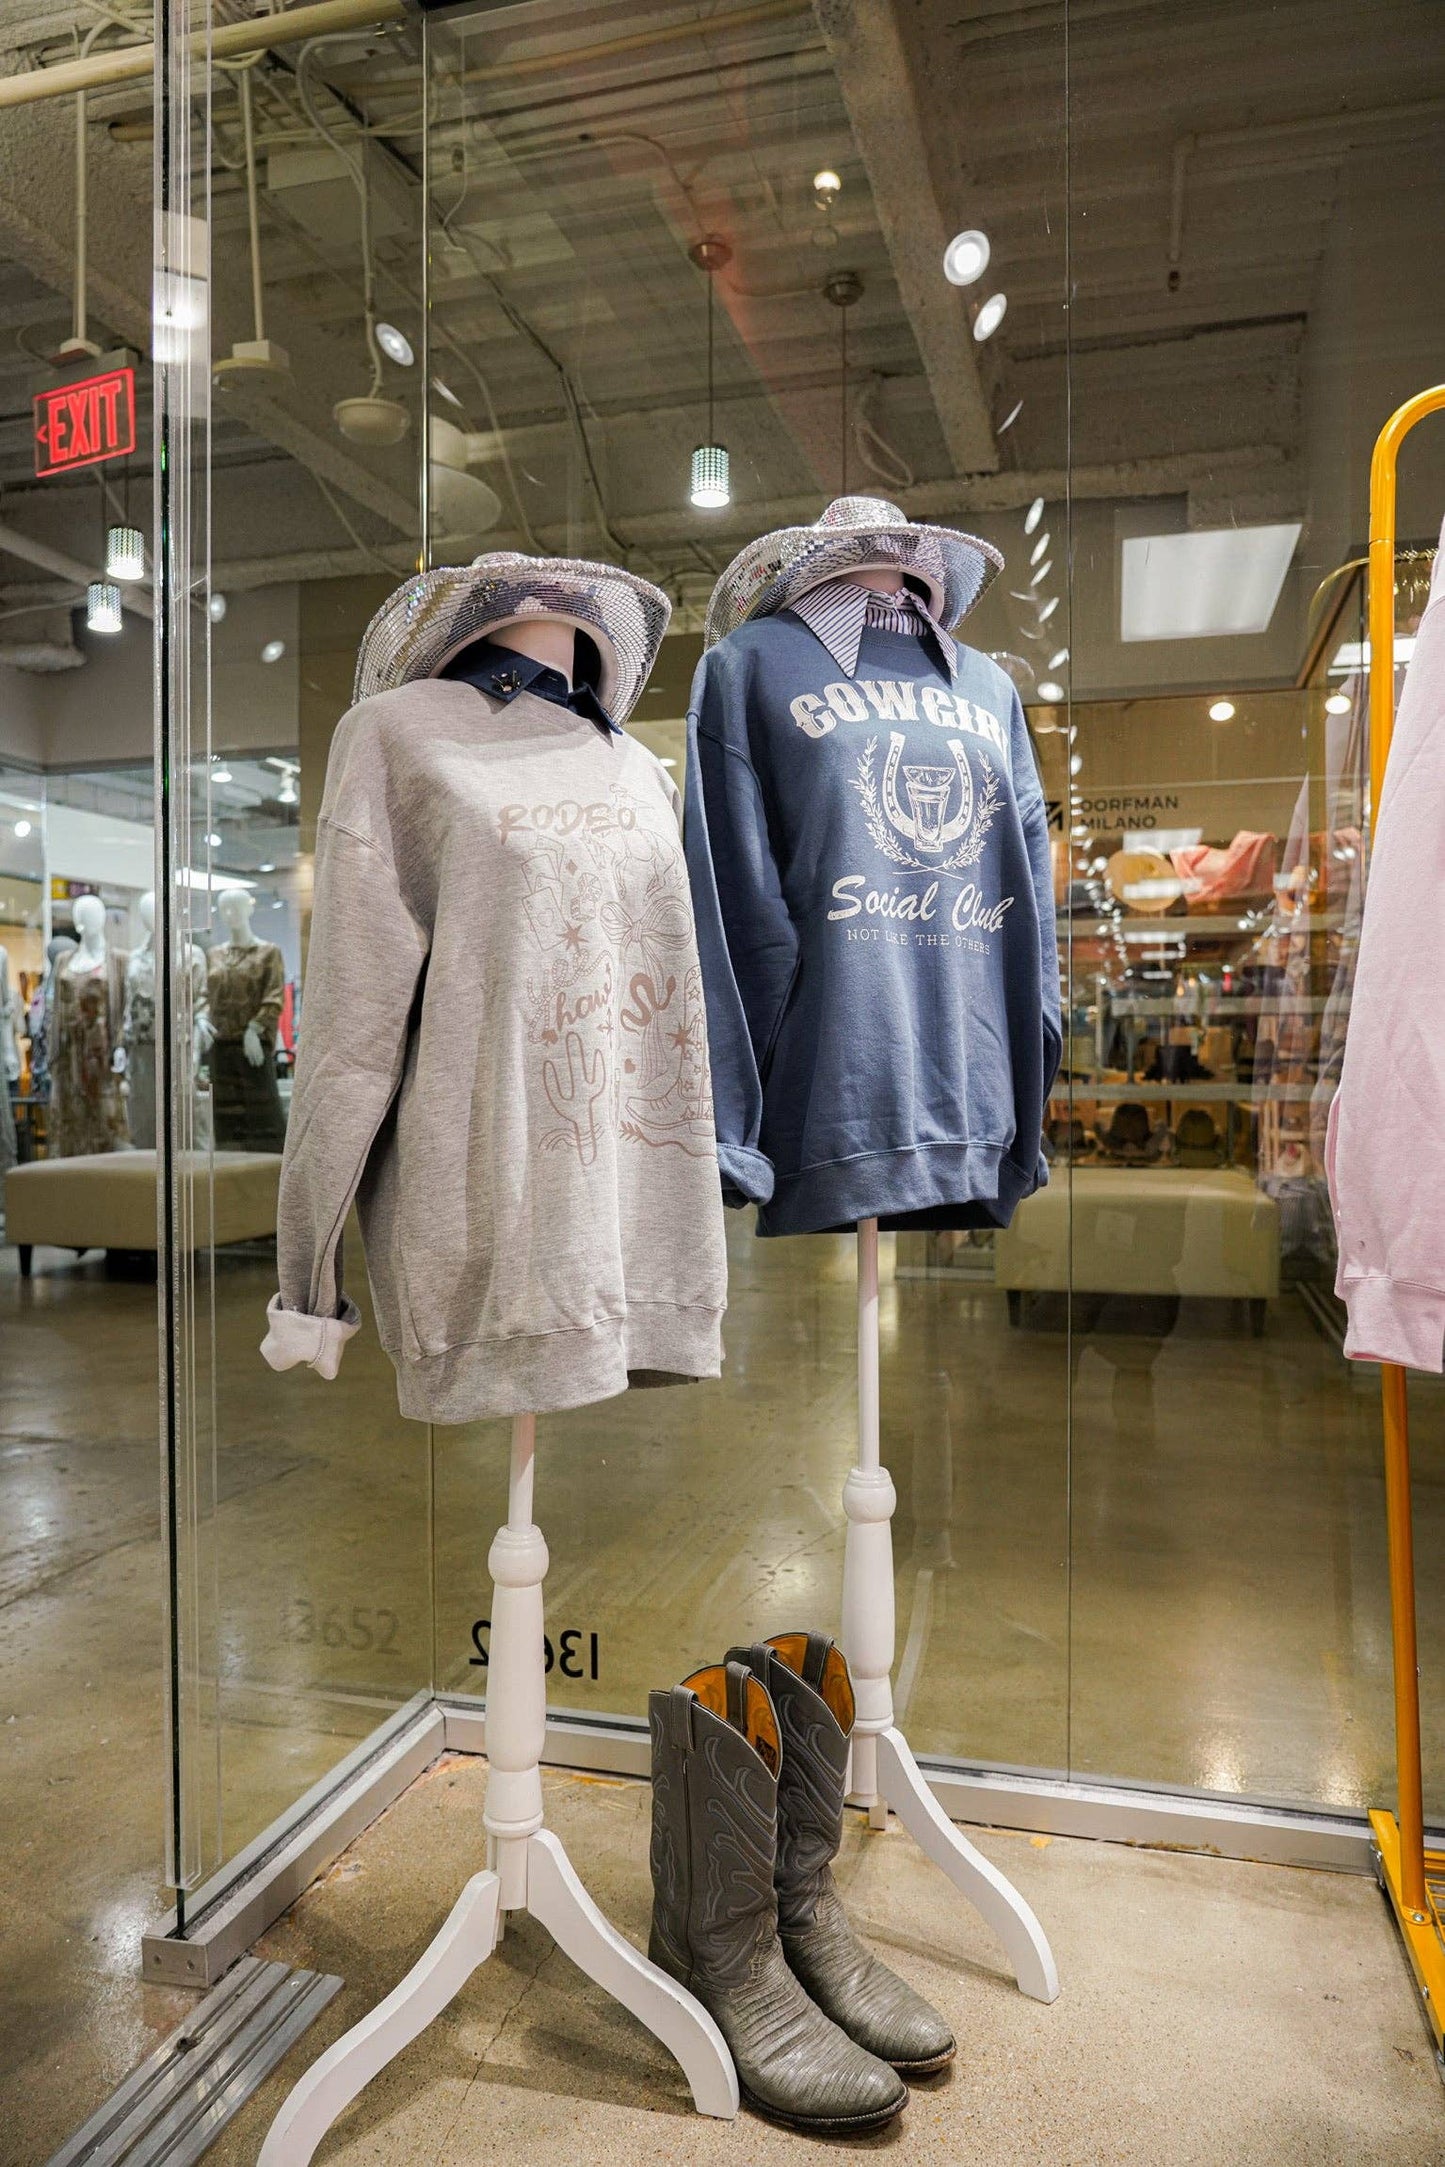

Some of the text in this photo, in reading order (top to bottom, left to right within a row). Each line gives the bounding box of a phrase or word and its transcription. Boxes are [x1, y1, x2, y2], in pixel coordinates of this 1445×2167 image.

[48, 379, 122, 464] EXIT
[1081, 796, 1178, 812] DORFMAN
[497, 800, 636, 845] RODEO
[1081, 816, 1156, 830] MILANO
[827, 874, 1015, 933] Social Club
[847, 928, 991, 956] NOT LIKE THE OTHERS
